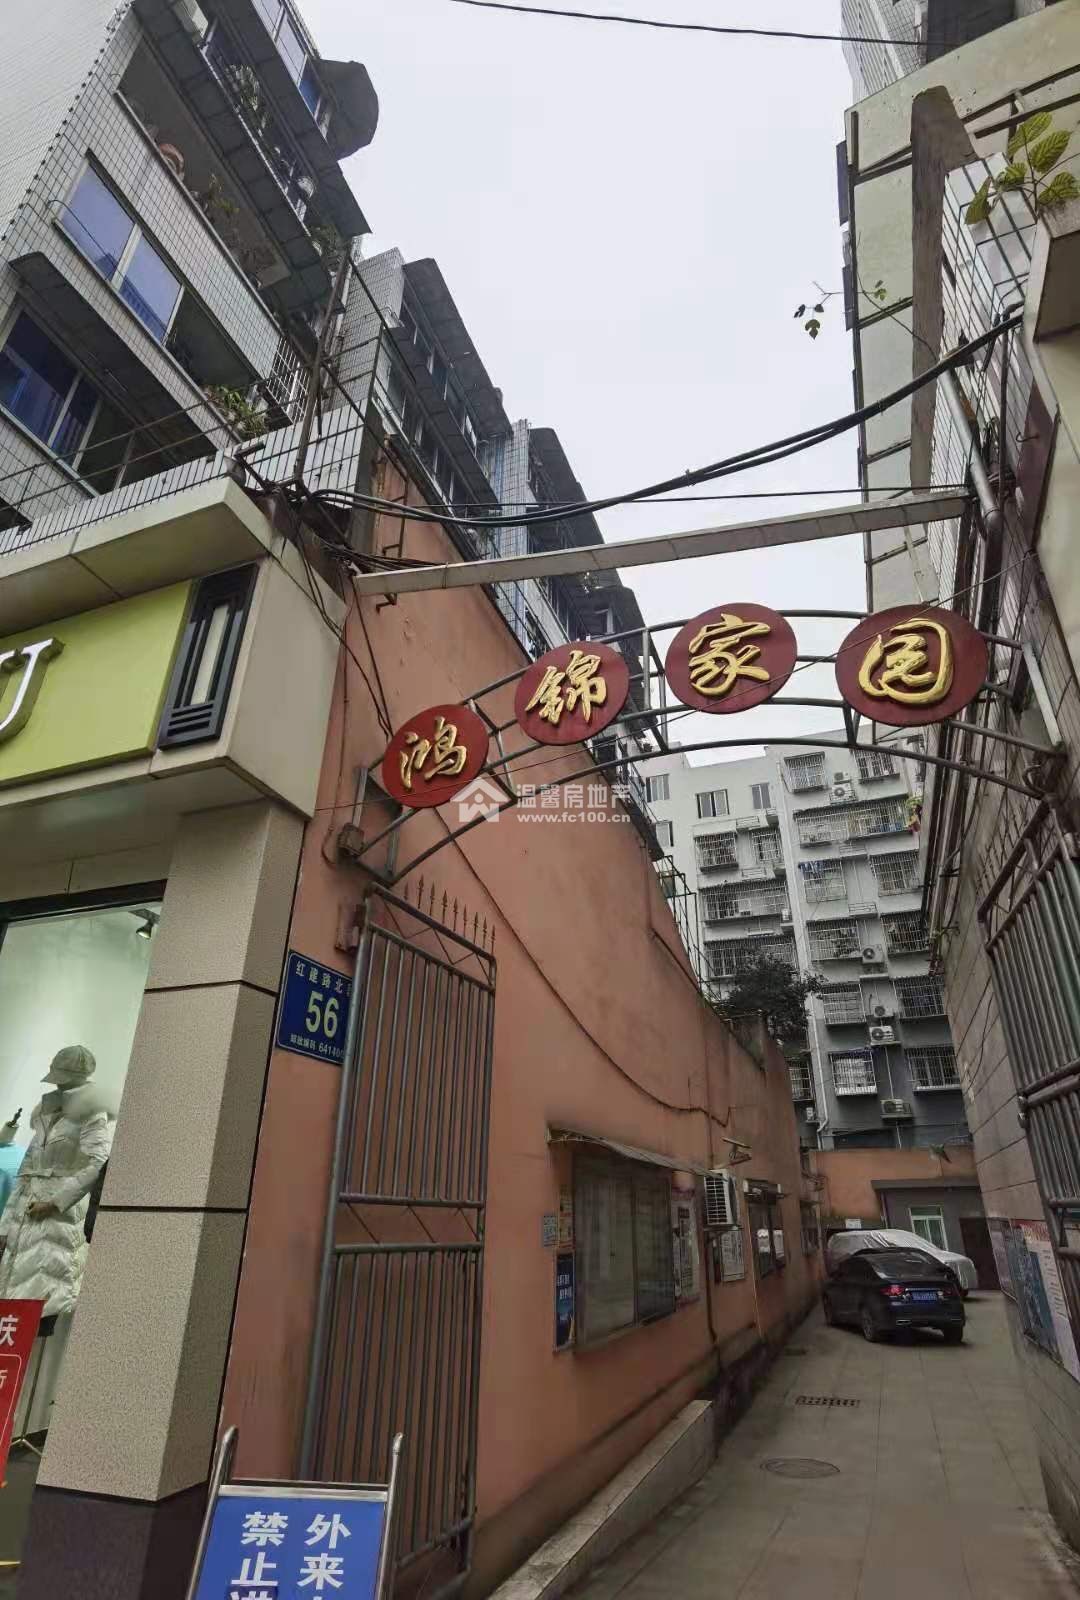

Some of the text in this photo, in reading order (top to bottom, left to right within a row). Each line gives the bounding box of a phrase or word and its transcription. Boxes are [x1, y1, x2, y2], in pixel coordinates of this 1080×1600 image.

[400, 614, 953, 790] 鸿锦家园
[305, 990, 339, 1038] 56
[228, 1511, 289, 1600] 禁止
[297, 1513, 352, 1600] 外来
